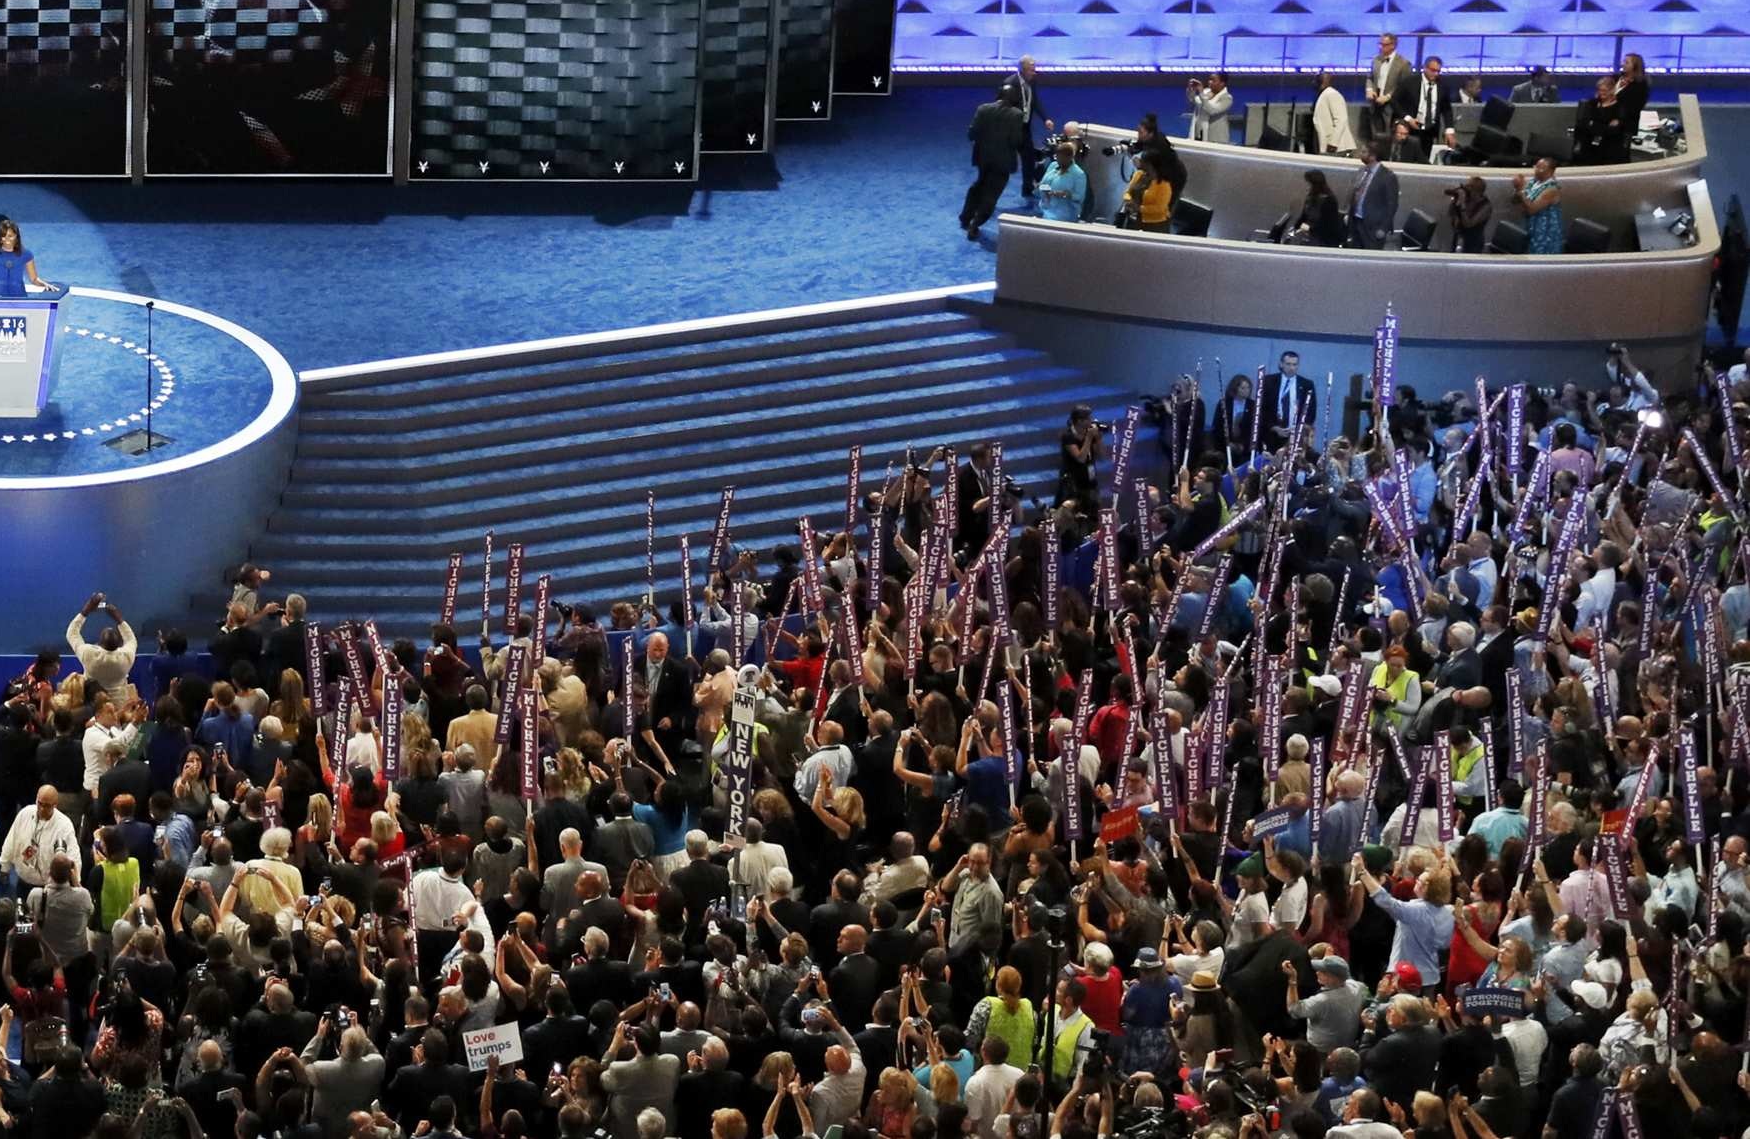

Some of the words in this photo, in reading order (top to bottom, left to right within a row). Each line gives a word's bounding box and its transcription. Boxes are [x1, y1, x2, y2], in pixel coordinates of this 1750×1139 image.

[1383, 318, 1396, 397] MICHELLE
[1114, 410, 1138, 484] MICHELLE
[1511, 390, 1522, 464] MICHELLE
[948, 454, 956, 529] MICHELLE
[992, 445, 1001, 523] MICHELLE
[1136, 482, 1149, 550] MICHELLE
[1396, 452, 1413, 529] MICHELLE
[1456, 453, 1490, 529] MICHELLE
[1514, 454, 1546, 532] MICHELLE
[711, 490, 733, 565] MICHELLE
[800, 518, 822, 602] MICHELLE
[870, 518, 882, 600] MICHELLE
[1102, 513, 1117, 600] MICHELLE
[506, 548, 522, 626] MICHELLE
[534, 579, 548, 660] MICHELLE
[962, 574, 976, 655] MICHELLE
[1047, 544, 1058, 620] MICHELLE
[1161, 556, 1193, 633] MICHELLE
[1201, 558, 1231, 634] MICHELLE
[1538, 557, 1562, 633] MICHELLE
[1640, 572, 1657, 650] MICHELLE
[733, 583, 743, 667] MICHELLE
[842, 595, 861, 676] MICHELLE
[908, 587, 918, 669] MICHELLE
[308, 626, 323, 708] MICHELLE
[340, 629, 370, 708] MICHELLE
[500, 650, 523, 734] MICHELLE
[387, 678, 398, 770] MICHELLE
[523, 694, 535, 789] MICHELLE
[732, 726, 749, 768] NEW
[1000, 685, 1014, 772] MICHELLE
[1116, 711, 1137, 799] MICHELLE
[1211, 690, 1224, 777] MICHELLE
[1271, 683, 1280, 771] MICHELLE
[1510, 675, 1522, 762] MICHELLE
[1063, 739, 1077, 829] MICHELLE
[1154, 717, 1172, 807] MICHELLE
[1313, 742, 1322, 832] MICHELLE
[1405, 749, 1432, 837] MICHELLE
[1438, 736, 1449, 829] MICHELLE
[1535, 744, 1546, 835] MICHELLE
[1622, 750, 1658, 841] MICHELLE
[1681, 732, 1701, 831] MICHELLE
[729, 775, 744, 836] YORK
[1602, 836, 1628, 911] MICHELLE
[465, 1032, 495, 1045] Love
[468, 1040, 512, 1057] trumps
